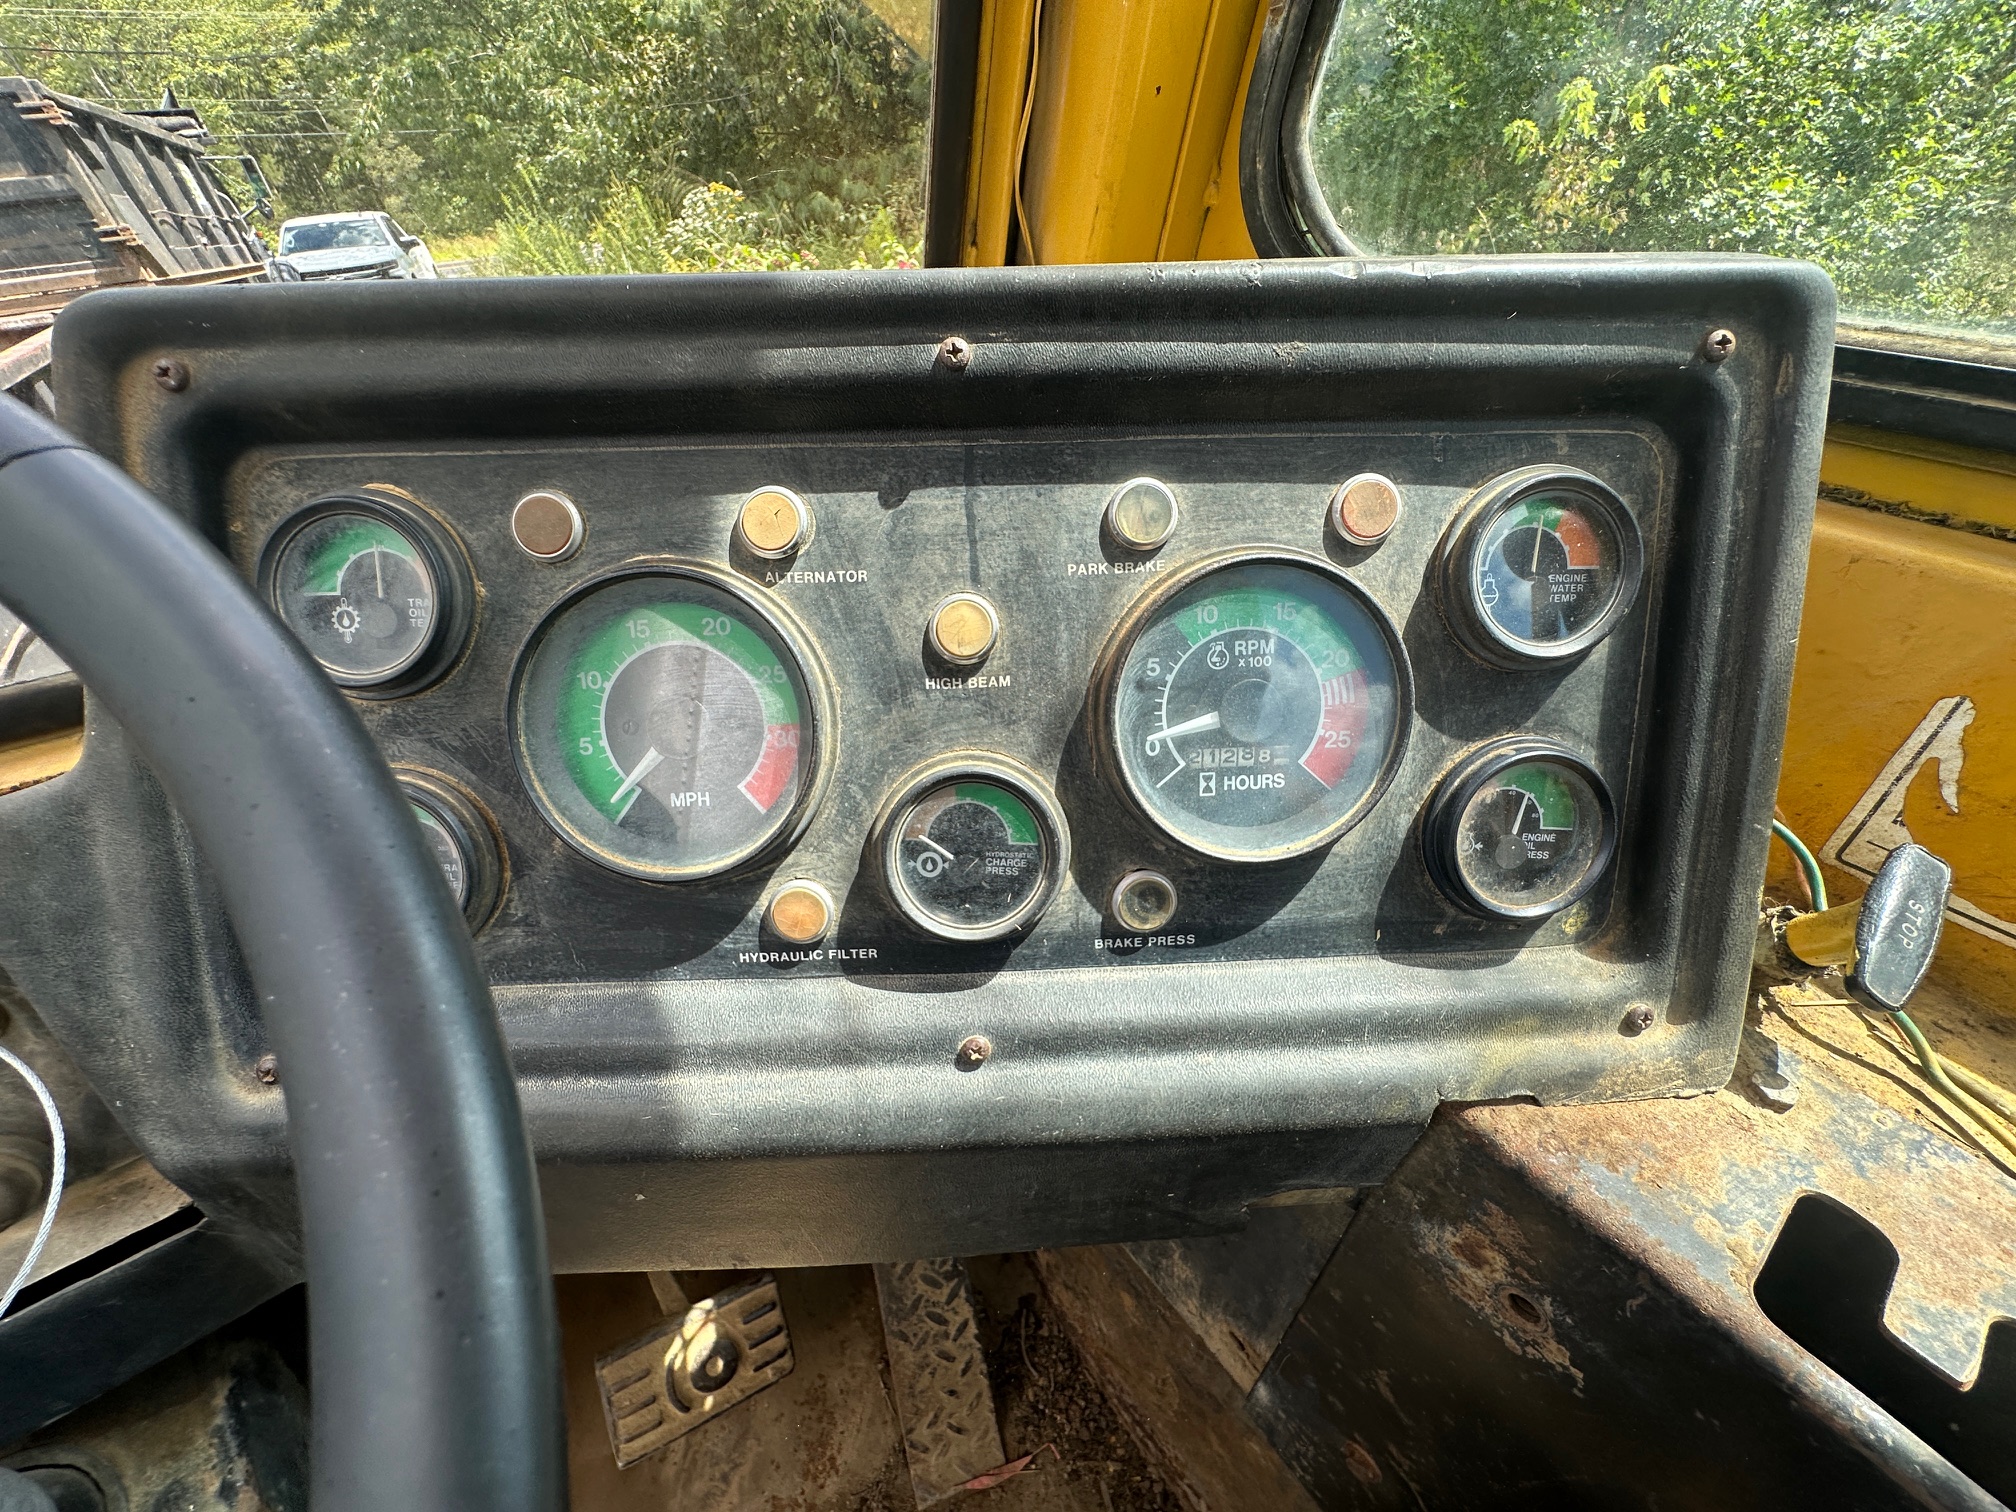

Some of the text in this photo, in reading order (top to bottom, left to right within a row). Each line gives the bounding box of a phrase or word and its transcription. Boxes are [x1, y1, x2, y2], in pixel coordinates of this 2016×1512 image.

[1067, 559, 1166, 576] PARK BRAKE
[765, 569, 868, 585] ALTERNATOR
[1548, 573, 1588, 583] ENGINE
[1549, 583, 1584, 593] WATER
[1549, 593, 1577, 603] TEMP
[409, 608, 428, 617] OIL
[1195, 604, 1219, 624] 10
[1272, 601, 1298, 621] 15
[625, 619, 651, 639] 15
[701, 616, 732, 637] 20
[1234, 638, 1275, 656] RPM
[1146, 657, 1161, 677] 5
[1321, 647, 1350, 669] 20
[576, 670, 603, 690] 10
[759, 664, 788, 684] 25
[925, 675, 1011, 690] HIGH BEAM
[579, 737, 594, 756] 5
[1145, 739, 1161, 757] 0
[1324, 730, 1352, 749] 25
[1223, 772, 1286, 791] HOURS
[670, 791, 711, 807] MPH
[1522, 832, 1557, 842] ENGINE
[985, 857, 1028, 868] CHARGE
[985, 866, 1019, 876] PRESS
[1898, 899, 1926, 950] STOP
[1094, 934, 1196, 949] BRAKE PRESS
[739, 948, 878, 963] HYDRAULIC FILTER
